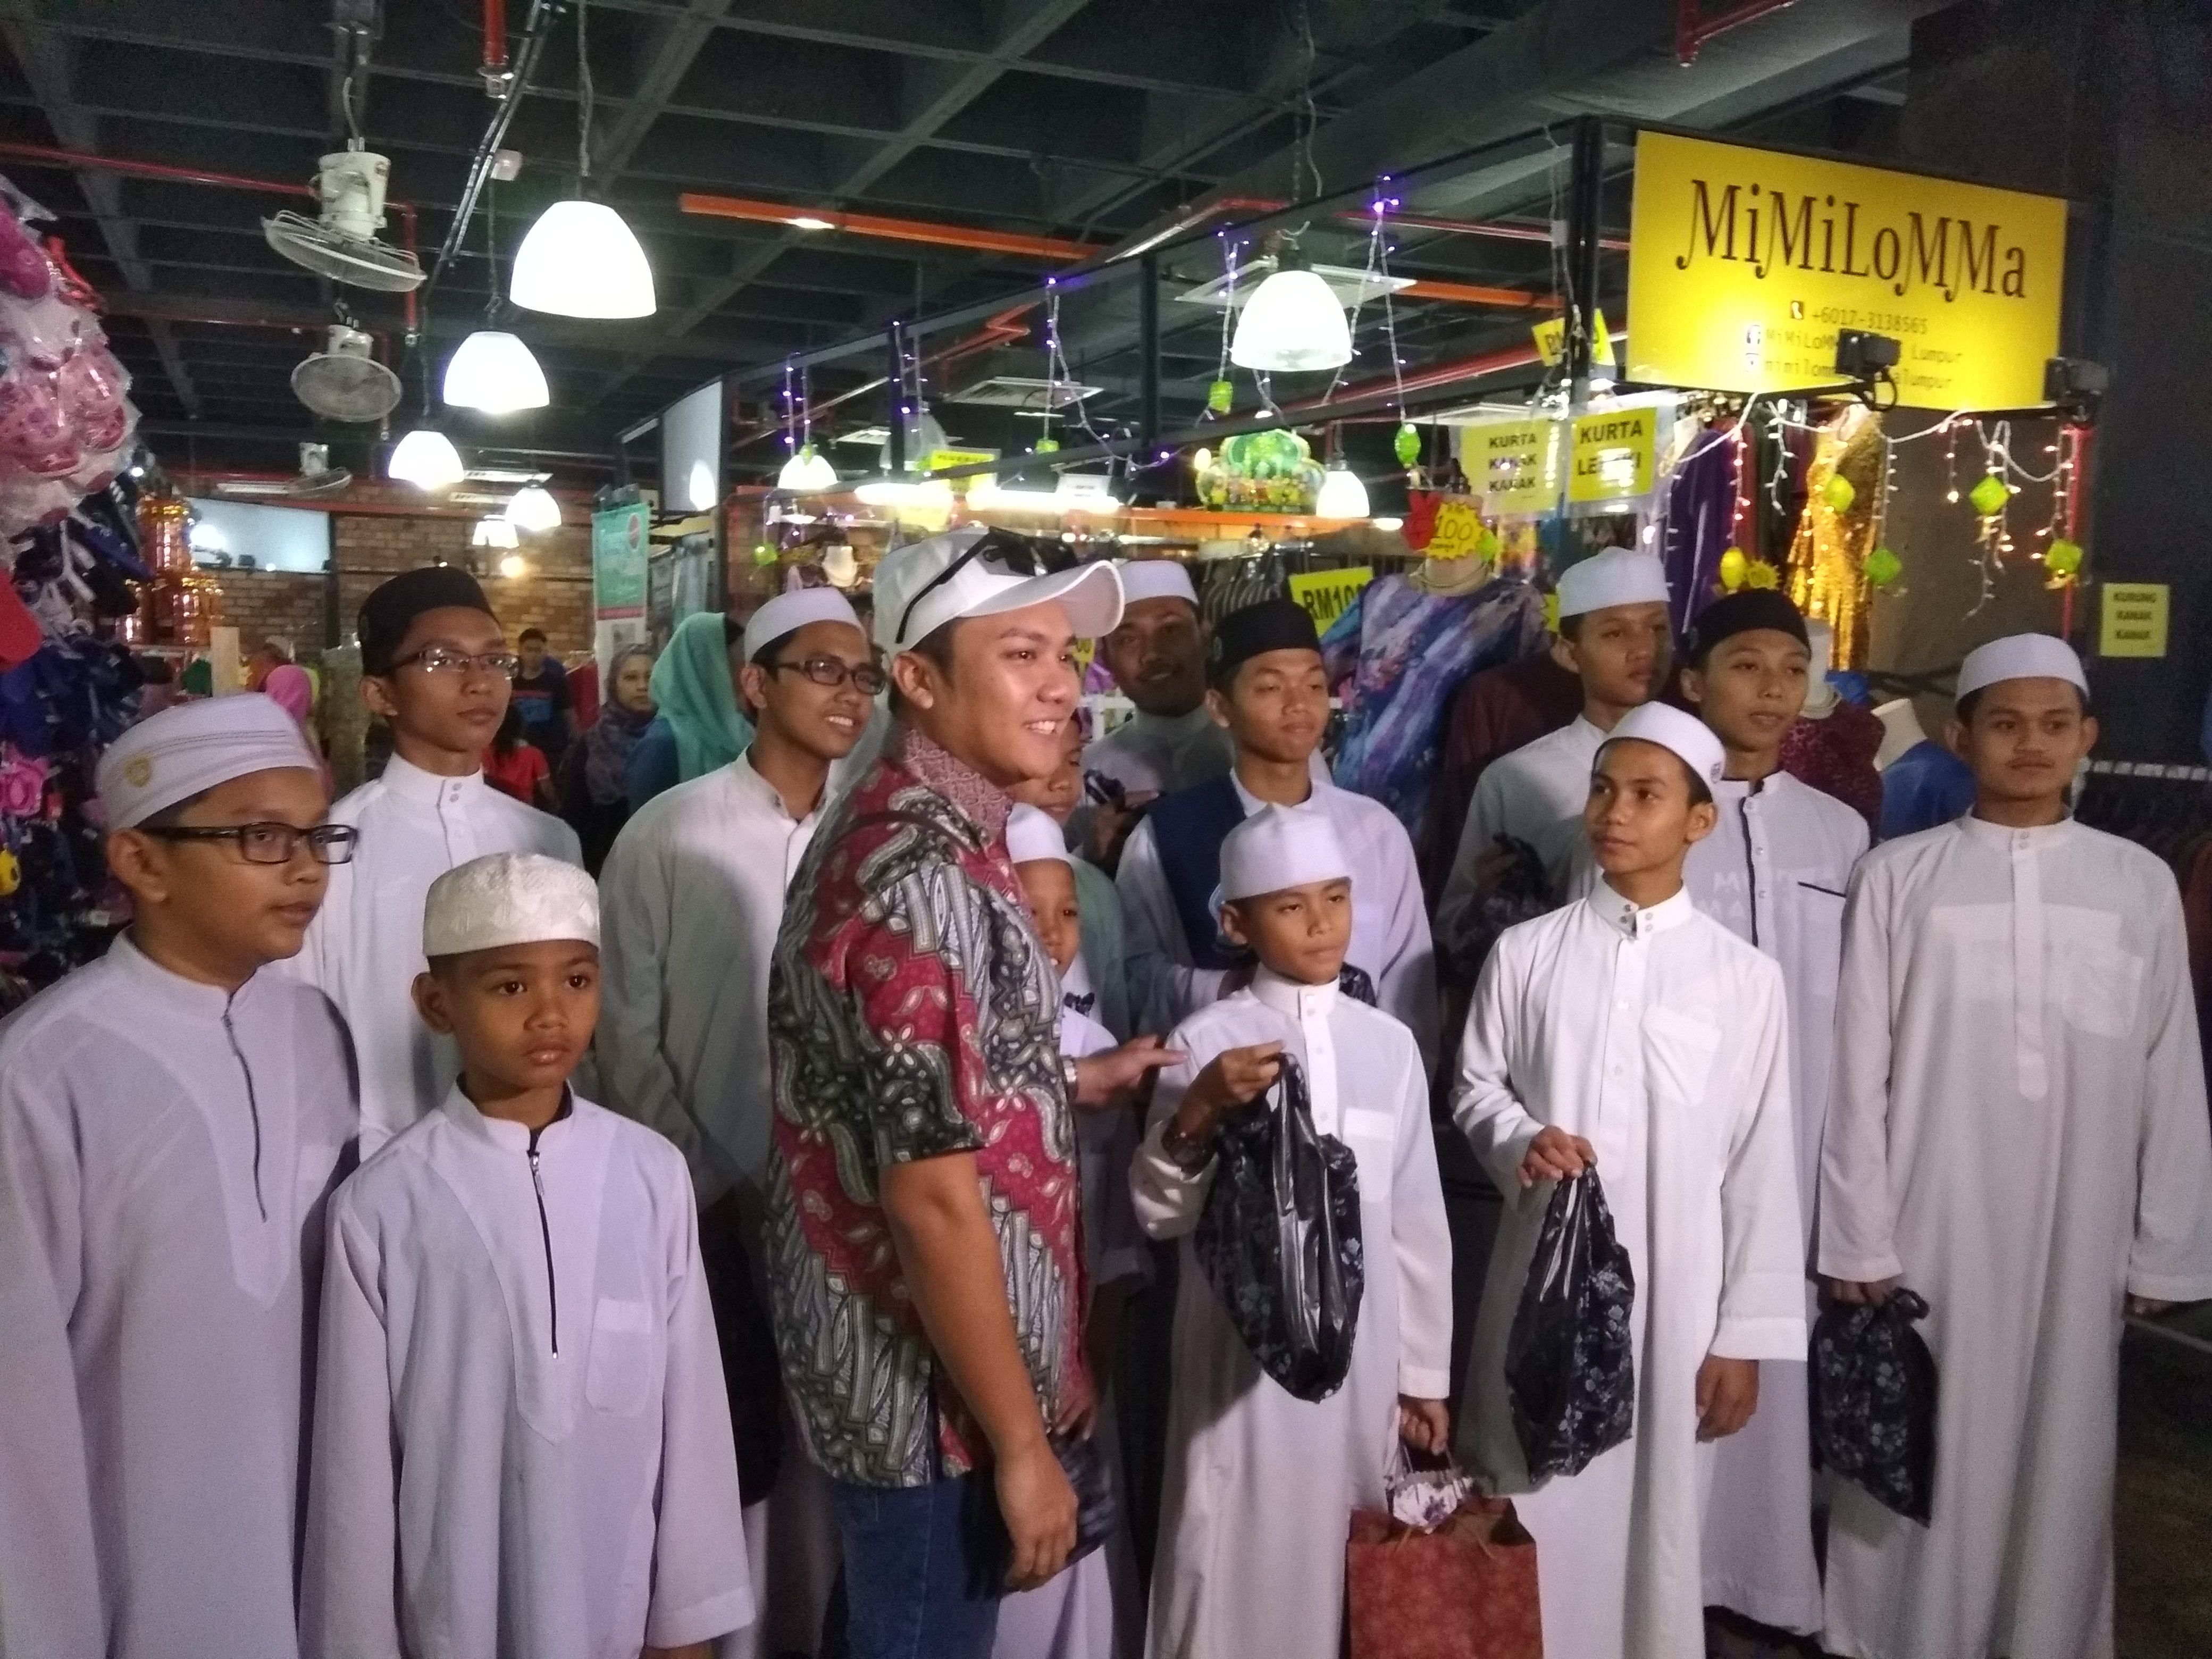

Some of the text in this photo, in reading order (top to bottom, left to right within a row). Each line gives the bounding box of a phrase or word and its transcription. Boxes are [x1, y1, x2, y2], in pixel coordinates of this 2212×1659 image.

[1676, 179, 2026, 302] MiMiLoMMa
[1489, 433, 1536, 448] KURTA
[1580, 420, 1643, 443] KURTA
